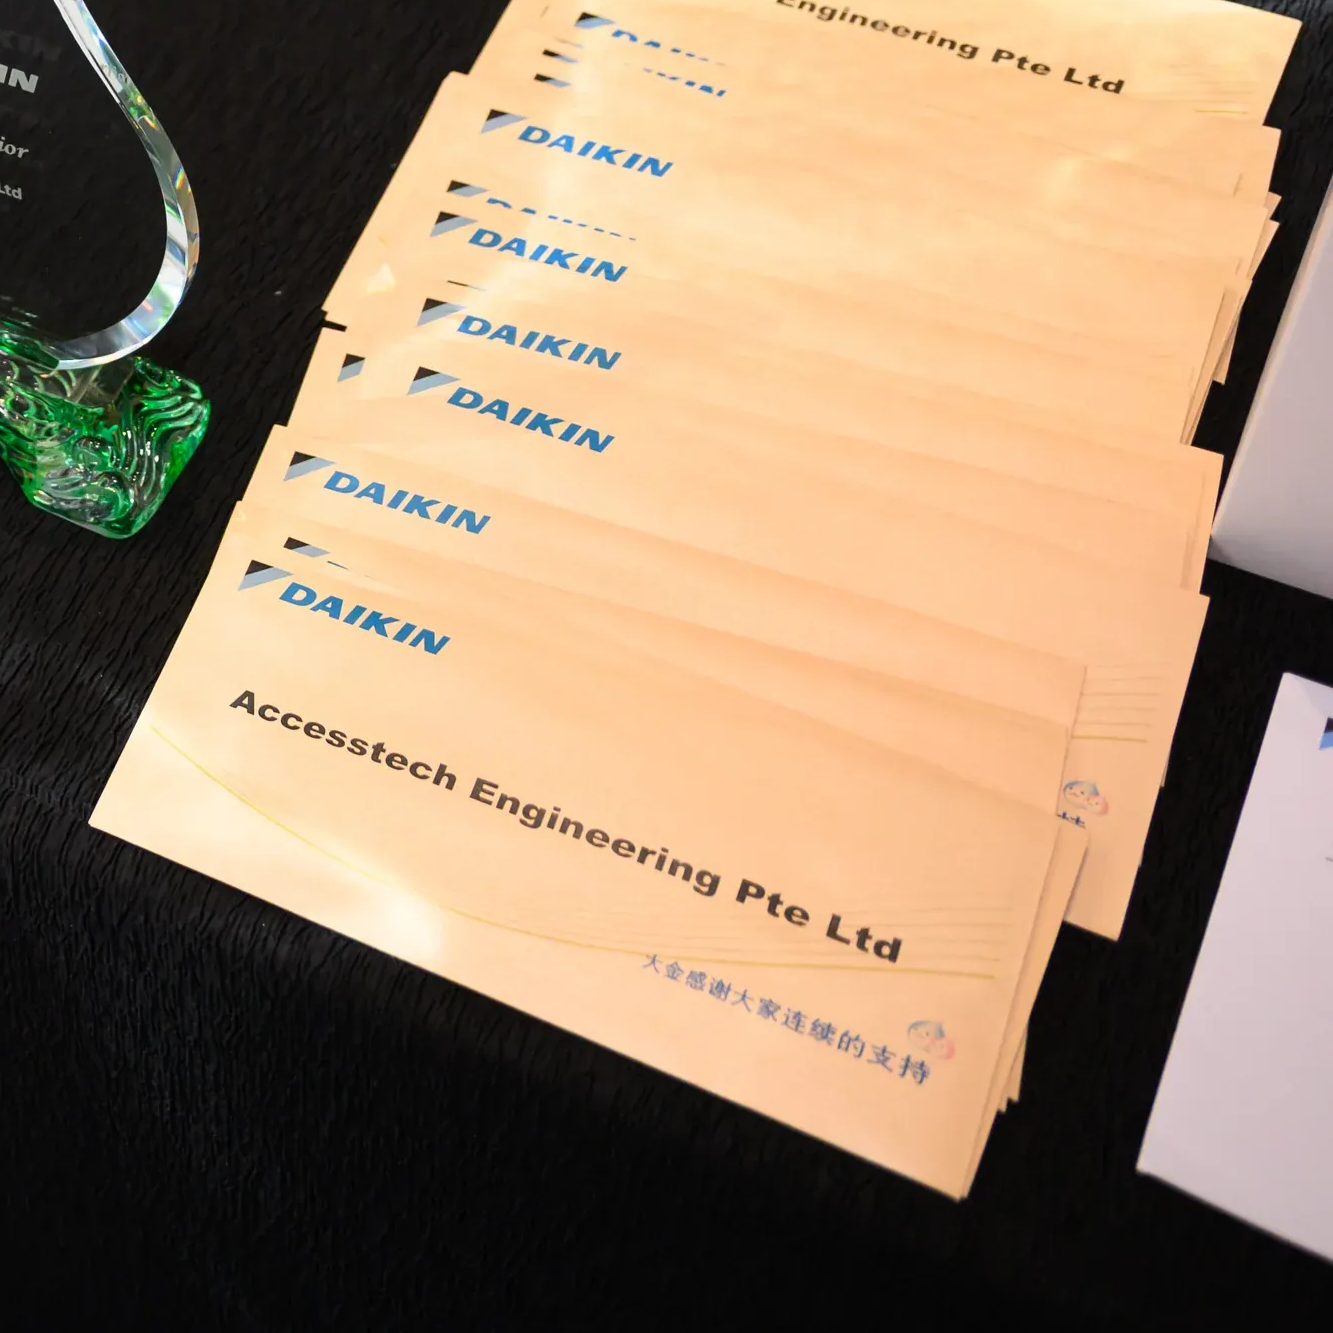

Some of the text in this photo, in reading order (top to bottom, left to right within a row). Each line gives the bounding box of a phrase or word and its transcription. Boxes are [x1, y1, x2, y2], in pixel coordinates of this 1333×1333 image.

[990, 47, 1052, 77] Pte
[1062, 67, 1126, 95] Ltd
[517, 125, 675, 178] DAIKIN
[468, 228, 628, 283] DAIKIN
[456, 315, 623, 371] DAIKIN
[446, 386, 616, 454] DAIKIN
[323, 470, 492, 535] DAIKIN
[278, 581, 452, 656] DAIKIN
[229, 689, 903, 964] Accesstech Engineering Pte Ltd
